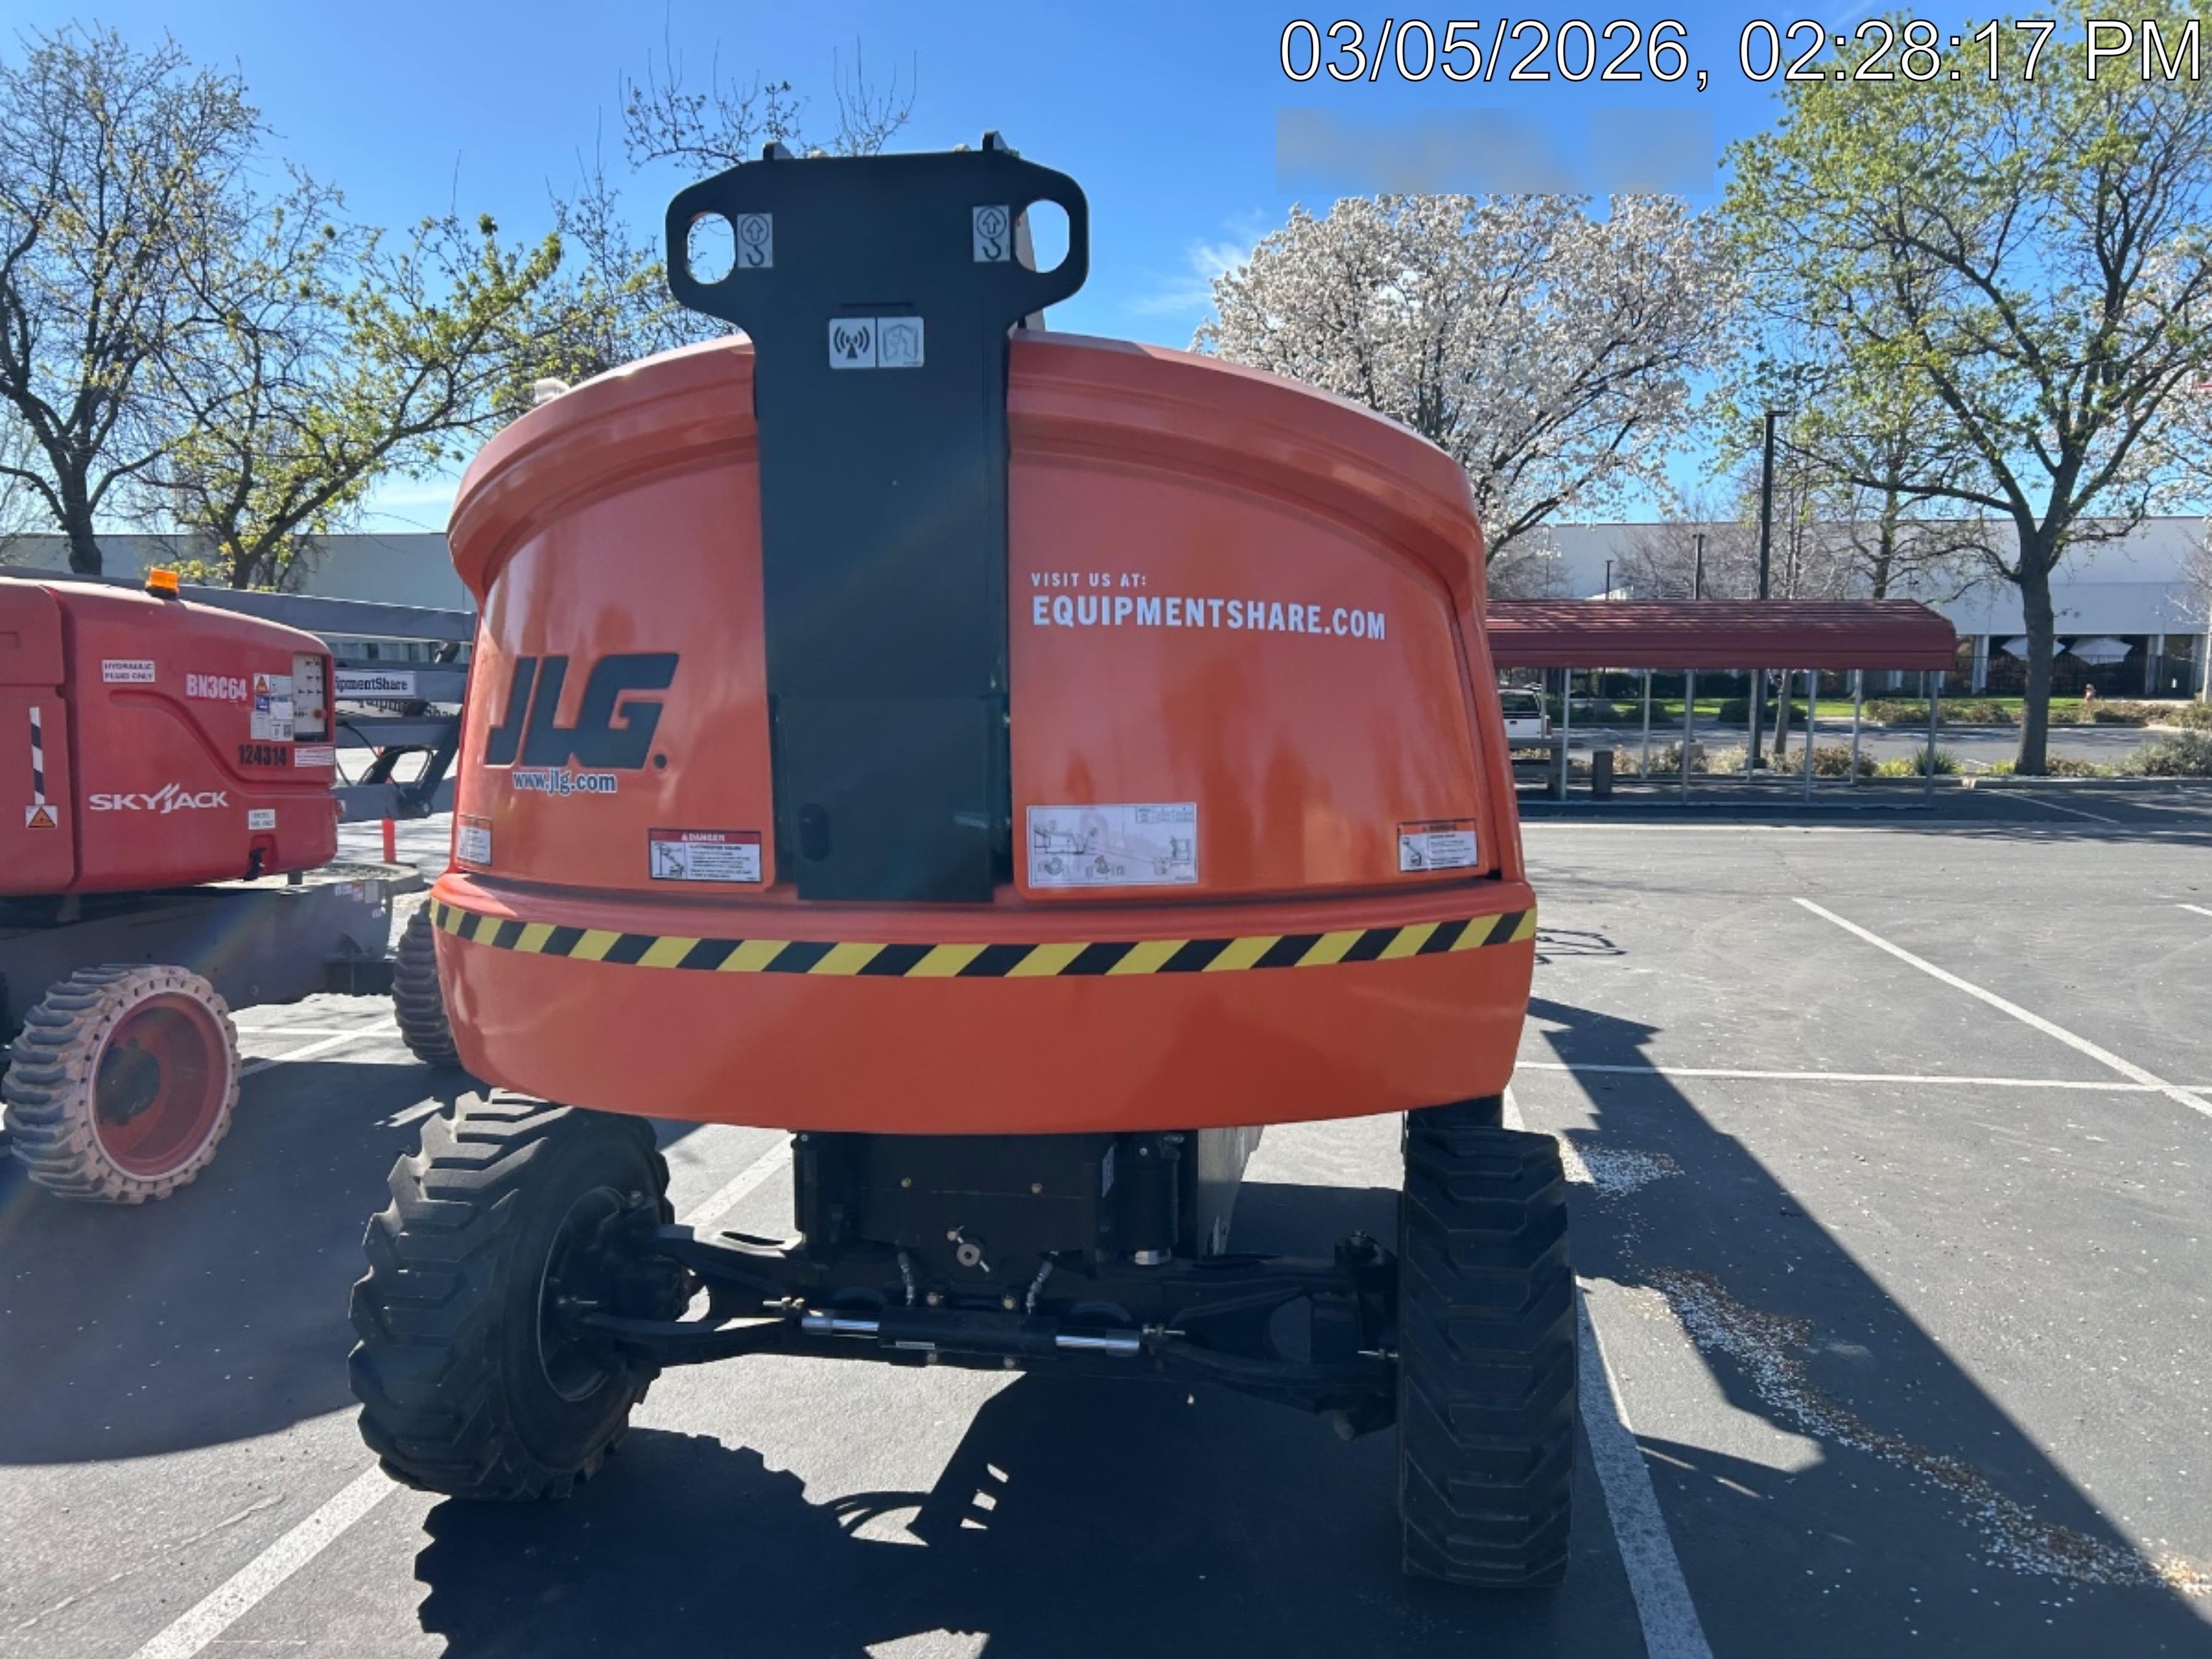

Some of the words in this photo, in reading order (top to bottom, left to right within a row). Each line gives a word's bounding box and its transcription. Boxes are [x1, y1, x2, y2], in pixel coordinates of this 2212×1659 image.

[1031, 572, 1079, 587] VISIT
[1088, 573, 1111, 588] US
[1120, 573, 1147, 588] AT:
[1033, 594, 1386, 640] EQUIPMENTSHARE.COM
[186, 673, 247, 701] BN3C64
[238, 743, 287, 766] 124314
[512, 767, 617, 796] www.jlg.com
[89, 782, 229, 814] SKYJACK
